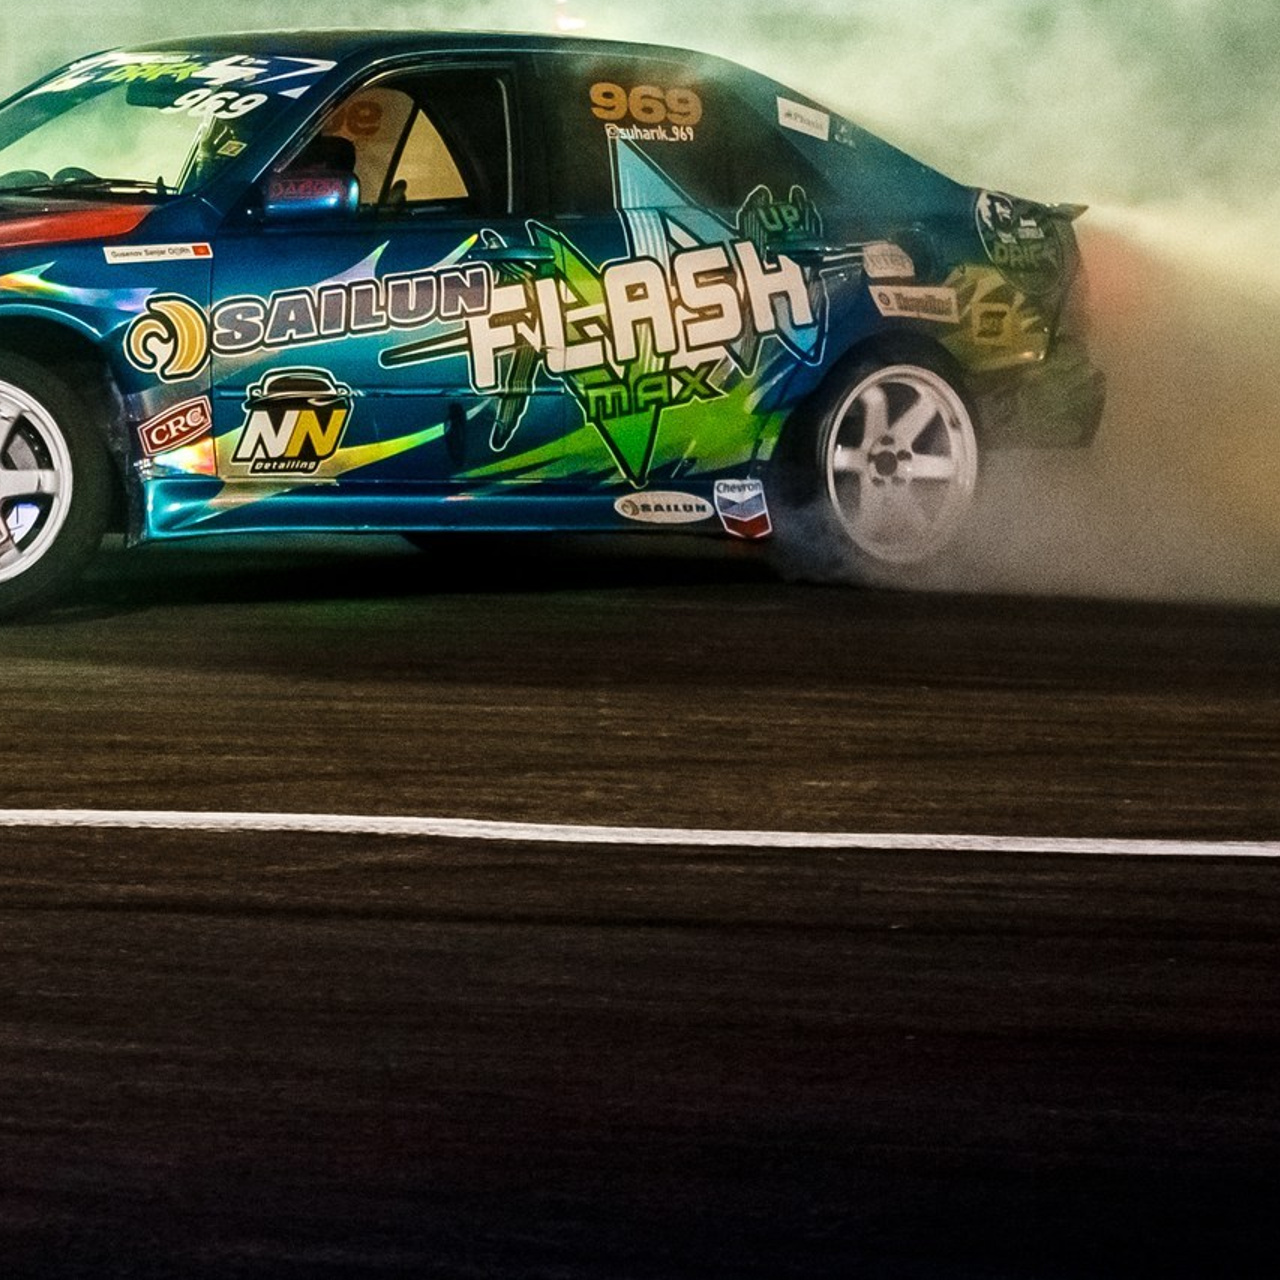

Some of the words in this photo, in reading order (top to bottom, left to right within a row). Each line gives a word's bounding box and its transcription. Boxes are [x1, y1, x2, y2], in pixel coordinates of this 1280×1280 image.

[160, 88, 269, 119] 969
[589, 82, 703, 124] 969
[212, 267, 490, 352] SAILUN
[469, 240, 814, 389] FLASH
[149, 405, 206, 447] CRC
[236, 409, 338, 459] NN
[254, 458, 319, 471] Detailing
[639, 503, 707, 513] SAILUN
[716, 481, 762, 494] Chevron
